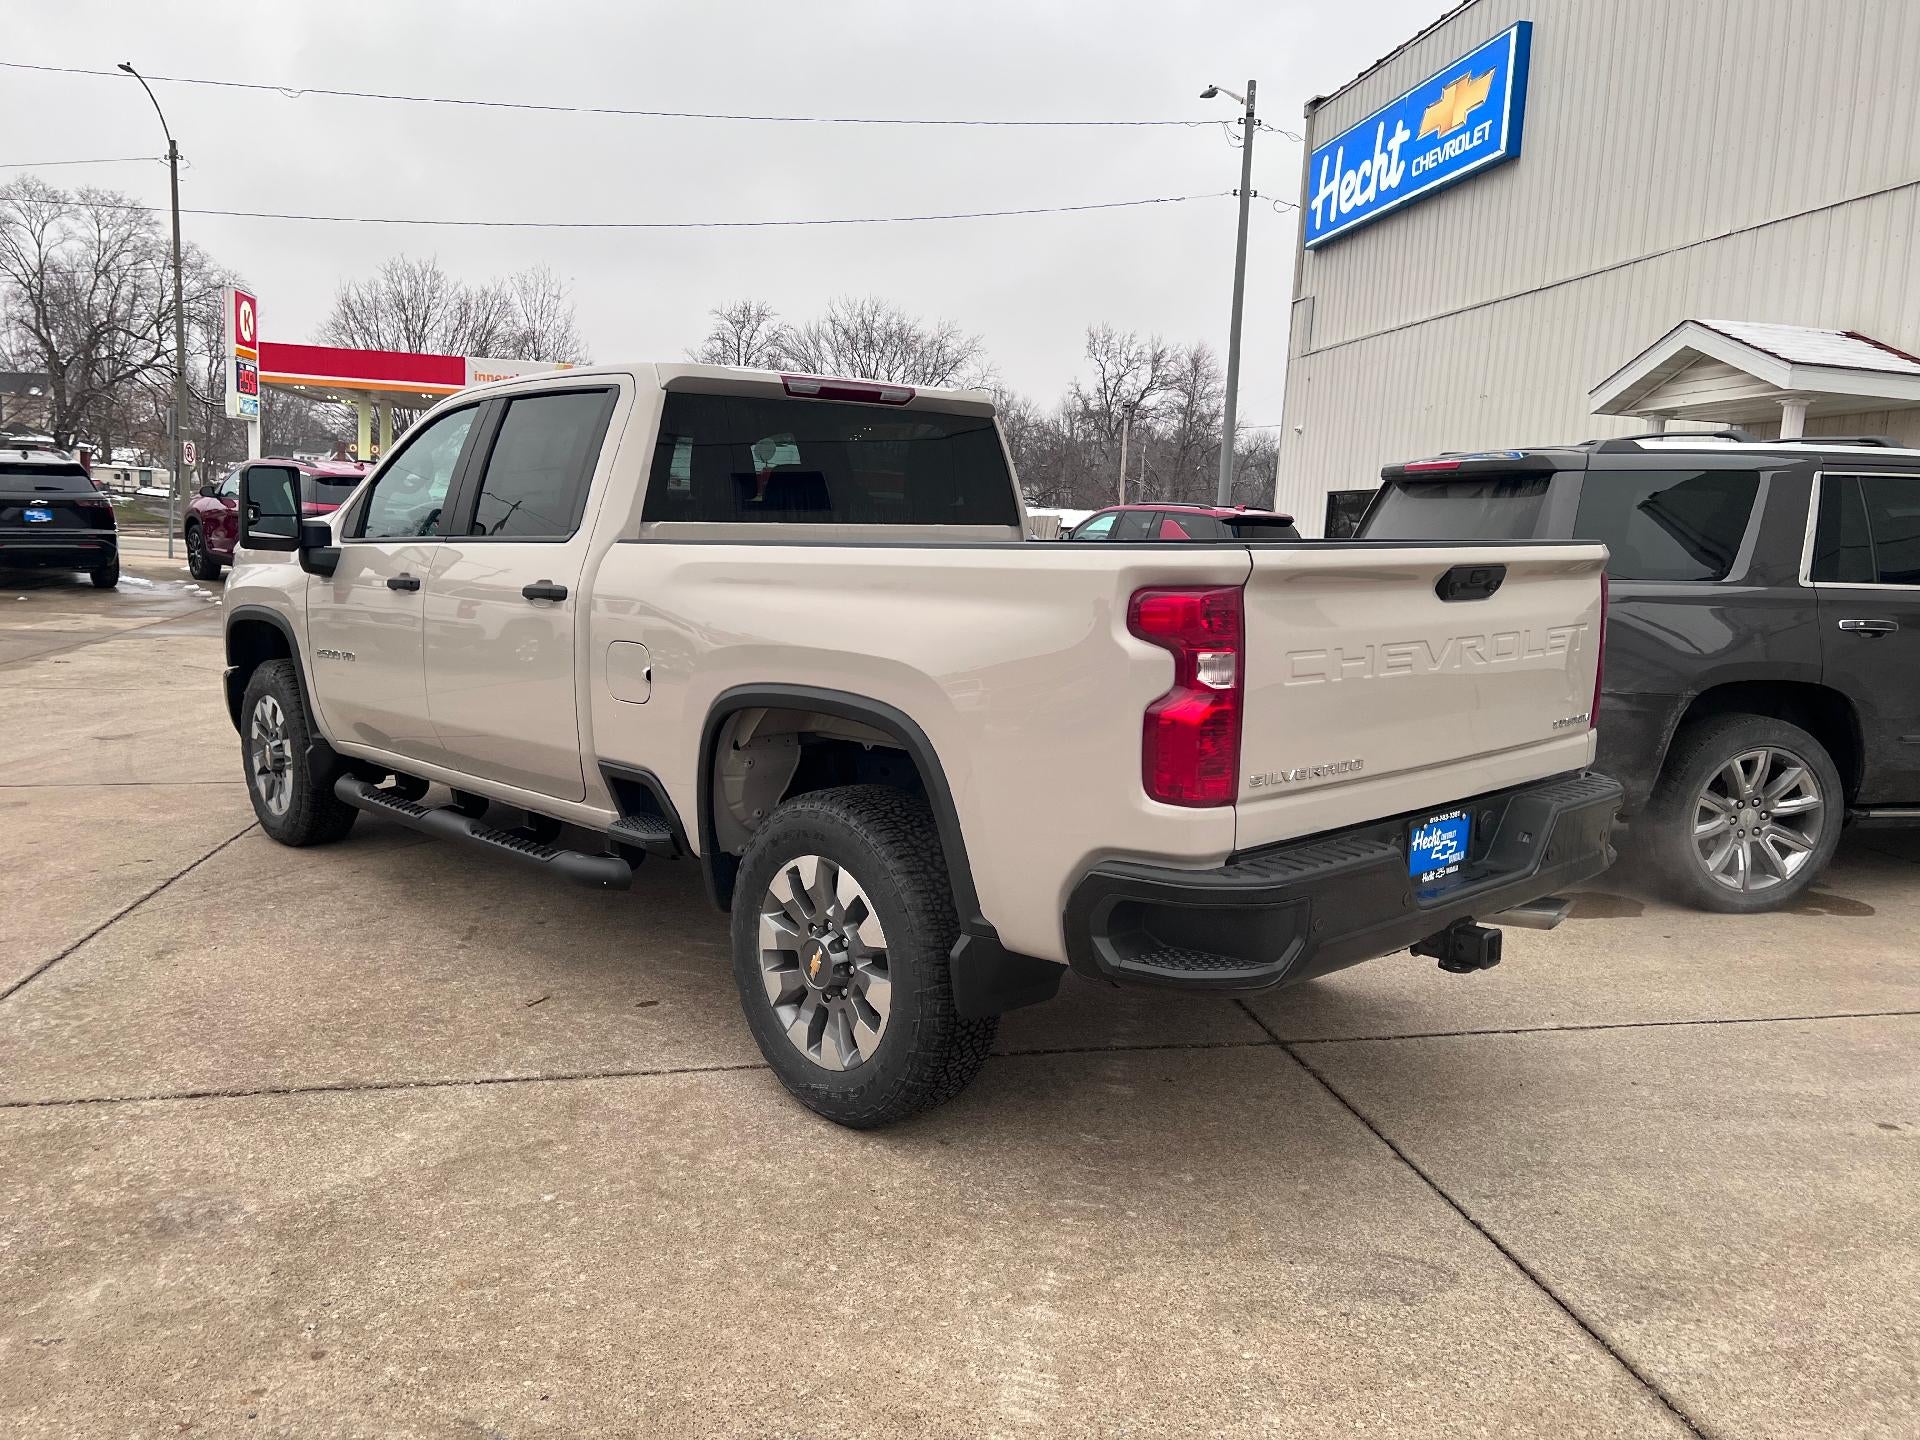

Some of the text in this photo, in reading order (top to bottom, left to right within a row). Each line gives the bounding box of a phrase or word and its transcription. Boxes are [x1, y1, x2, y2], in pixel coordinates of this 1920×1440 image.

[1312, 120, 1493, 230] Hecht CHEVROLET
[1284, 623, 1587, 686] CHEVROLET
[1249, 759, 1364, 788] SILVERADO
[1412, 827, 1441, 851] Hecht
